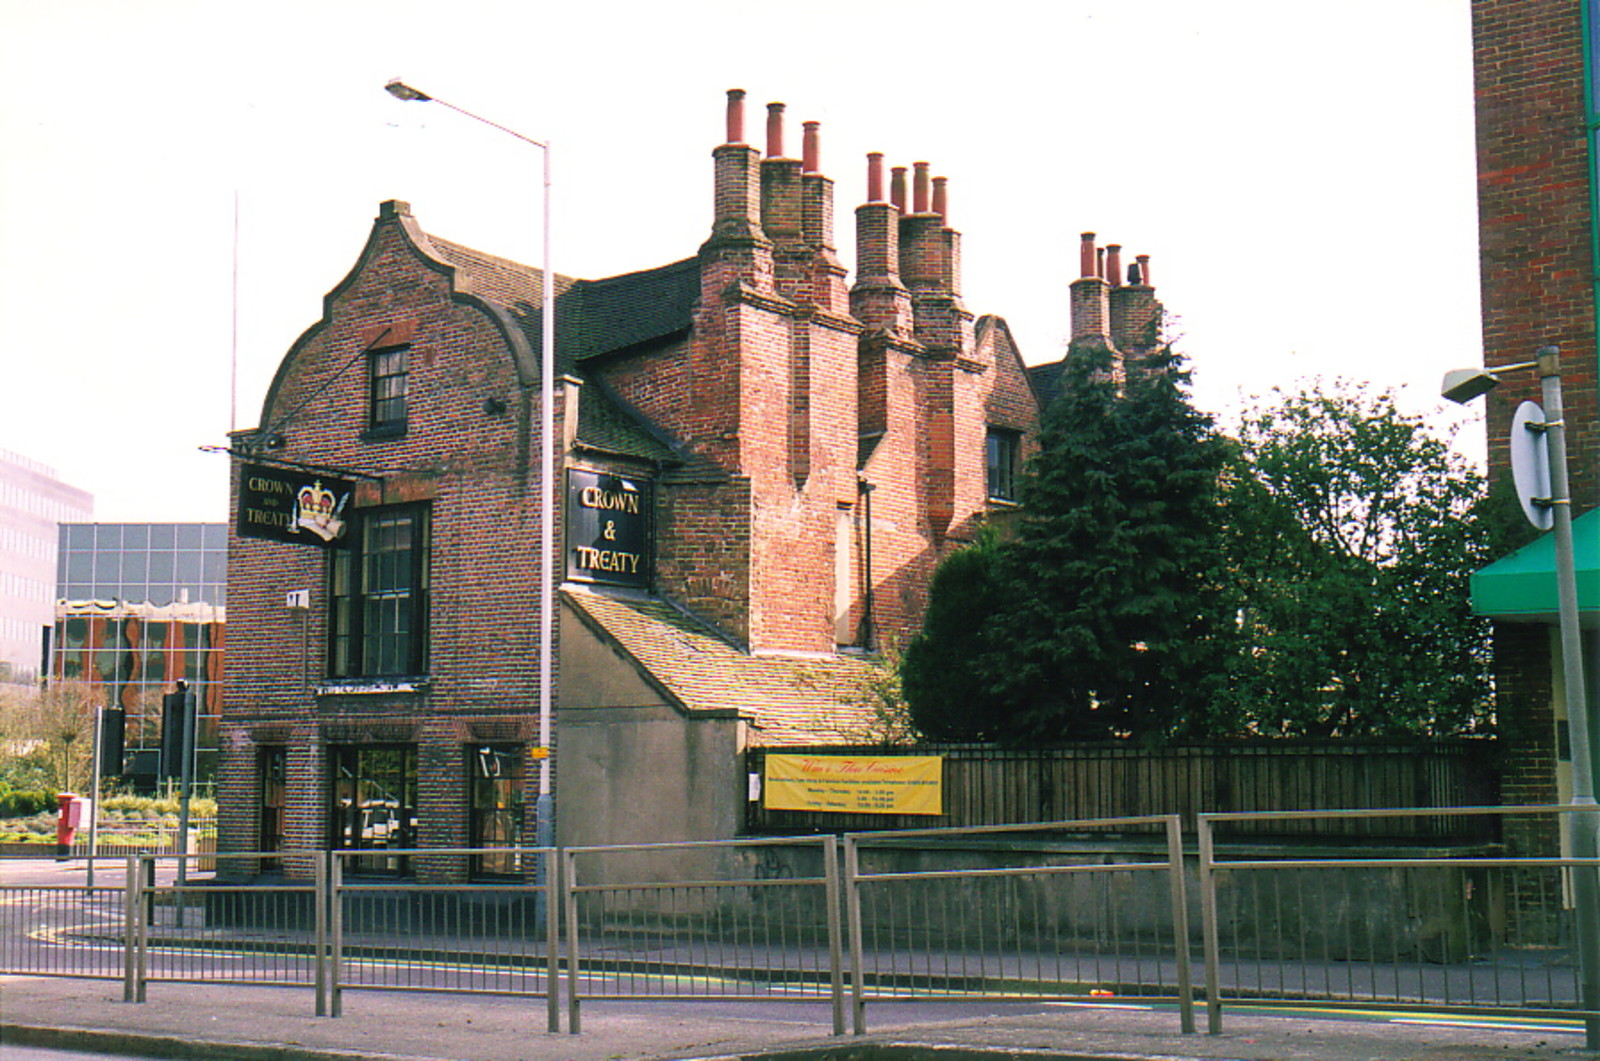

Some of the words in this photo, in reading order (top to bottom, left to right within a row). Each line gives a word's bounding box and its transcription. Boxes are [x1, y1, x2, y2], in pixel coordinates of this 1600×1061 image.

[249, 477, 294, 495] CROWN
[581, 486, 639, 514] CROWN
[246, 507, 292, 526] TREATY
[604, 520, 616, 541] &
[576, 545, 640, 573] TREATY
